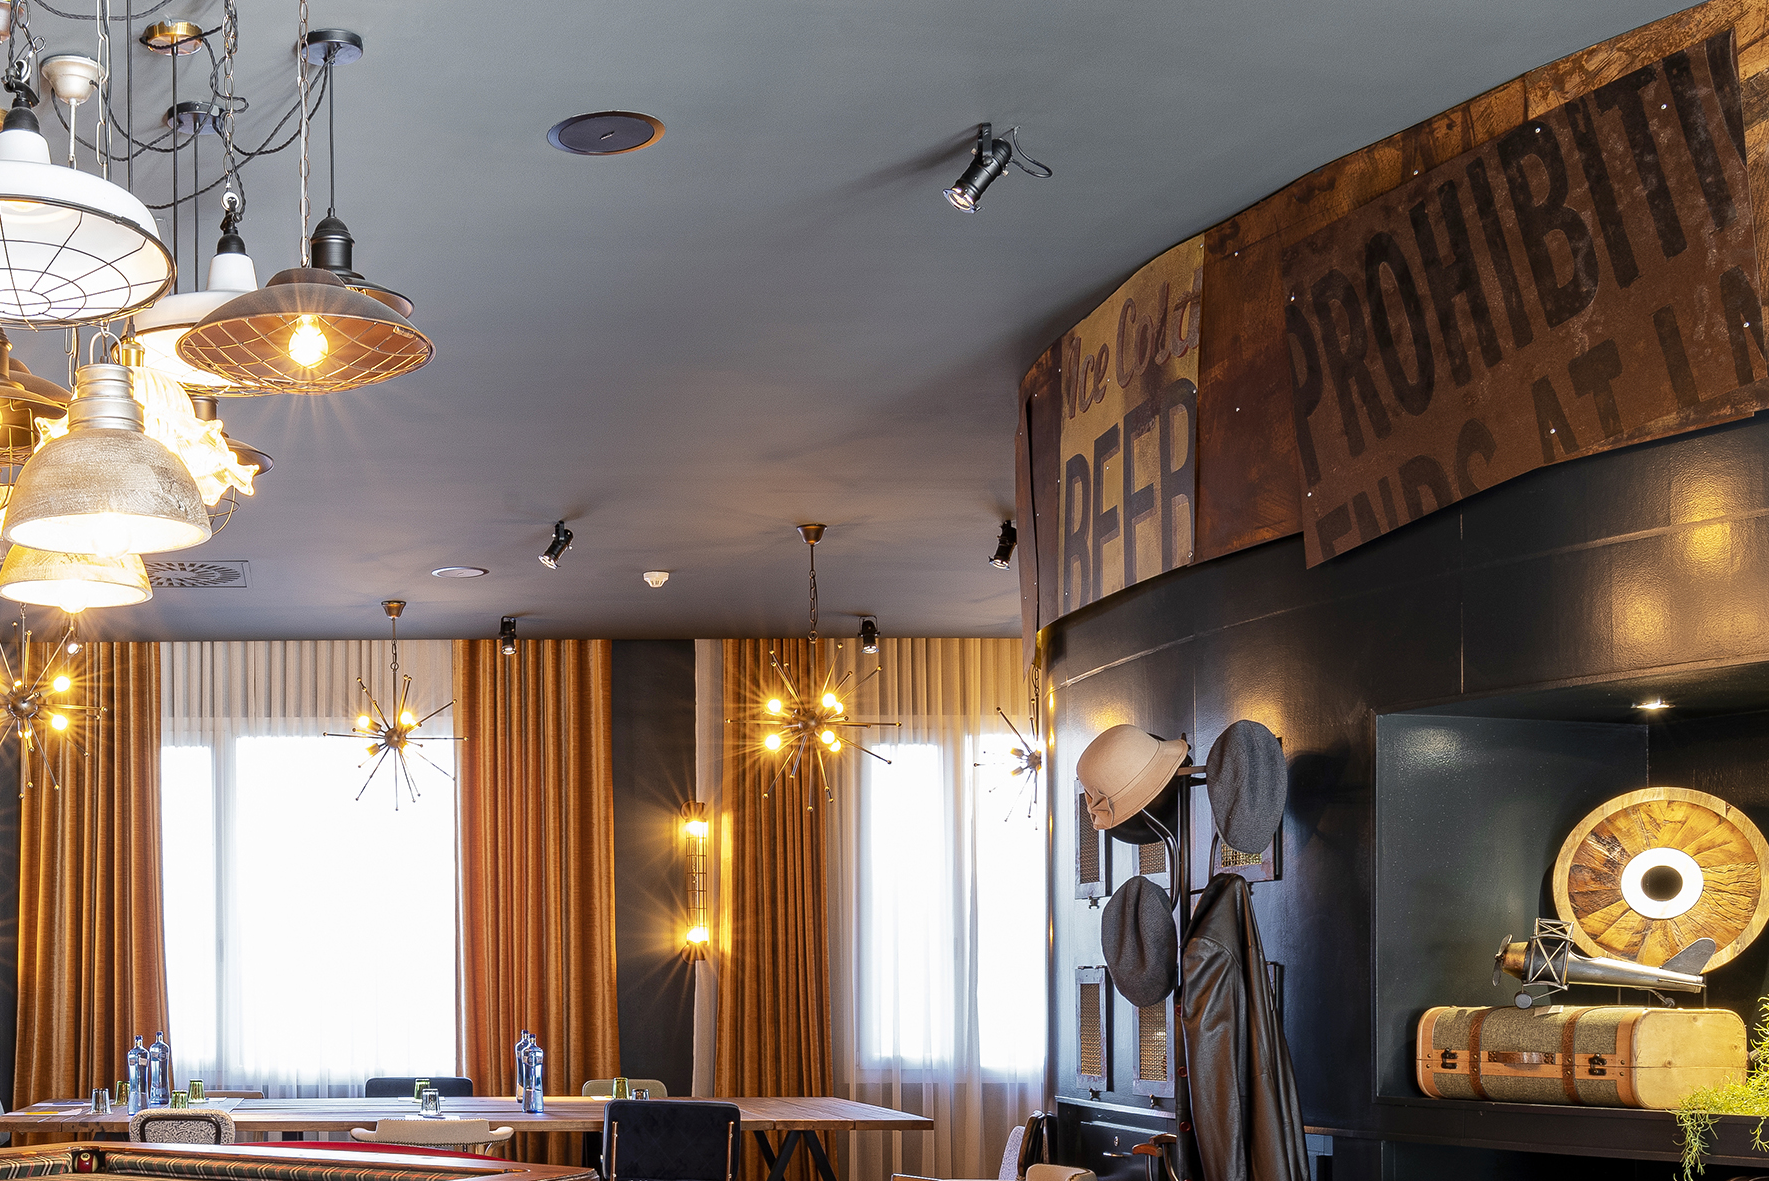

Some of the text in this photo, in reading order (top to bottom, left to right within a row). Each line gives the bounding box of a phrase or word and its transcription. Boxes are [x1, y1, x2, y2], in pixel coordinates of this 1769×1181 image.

[1067, 265, 1203, 420] Ice Cold
[1284, 29, 1748, 488] PROHIBITI
[1063, 376, 1198, 615] BEER
[1531, 338, 1624, 465] AT
